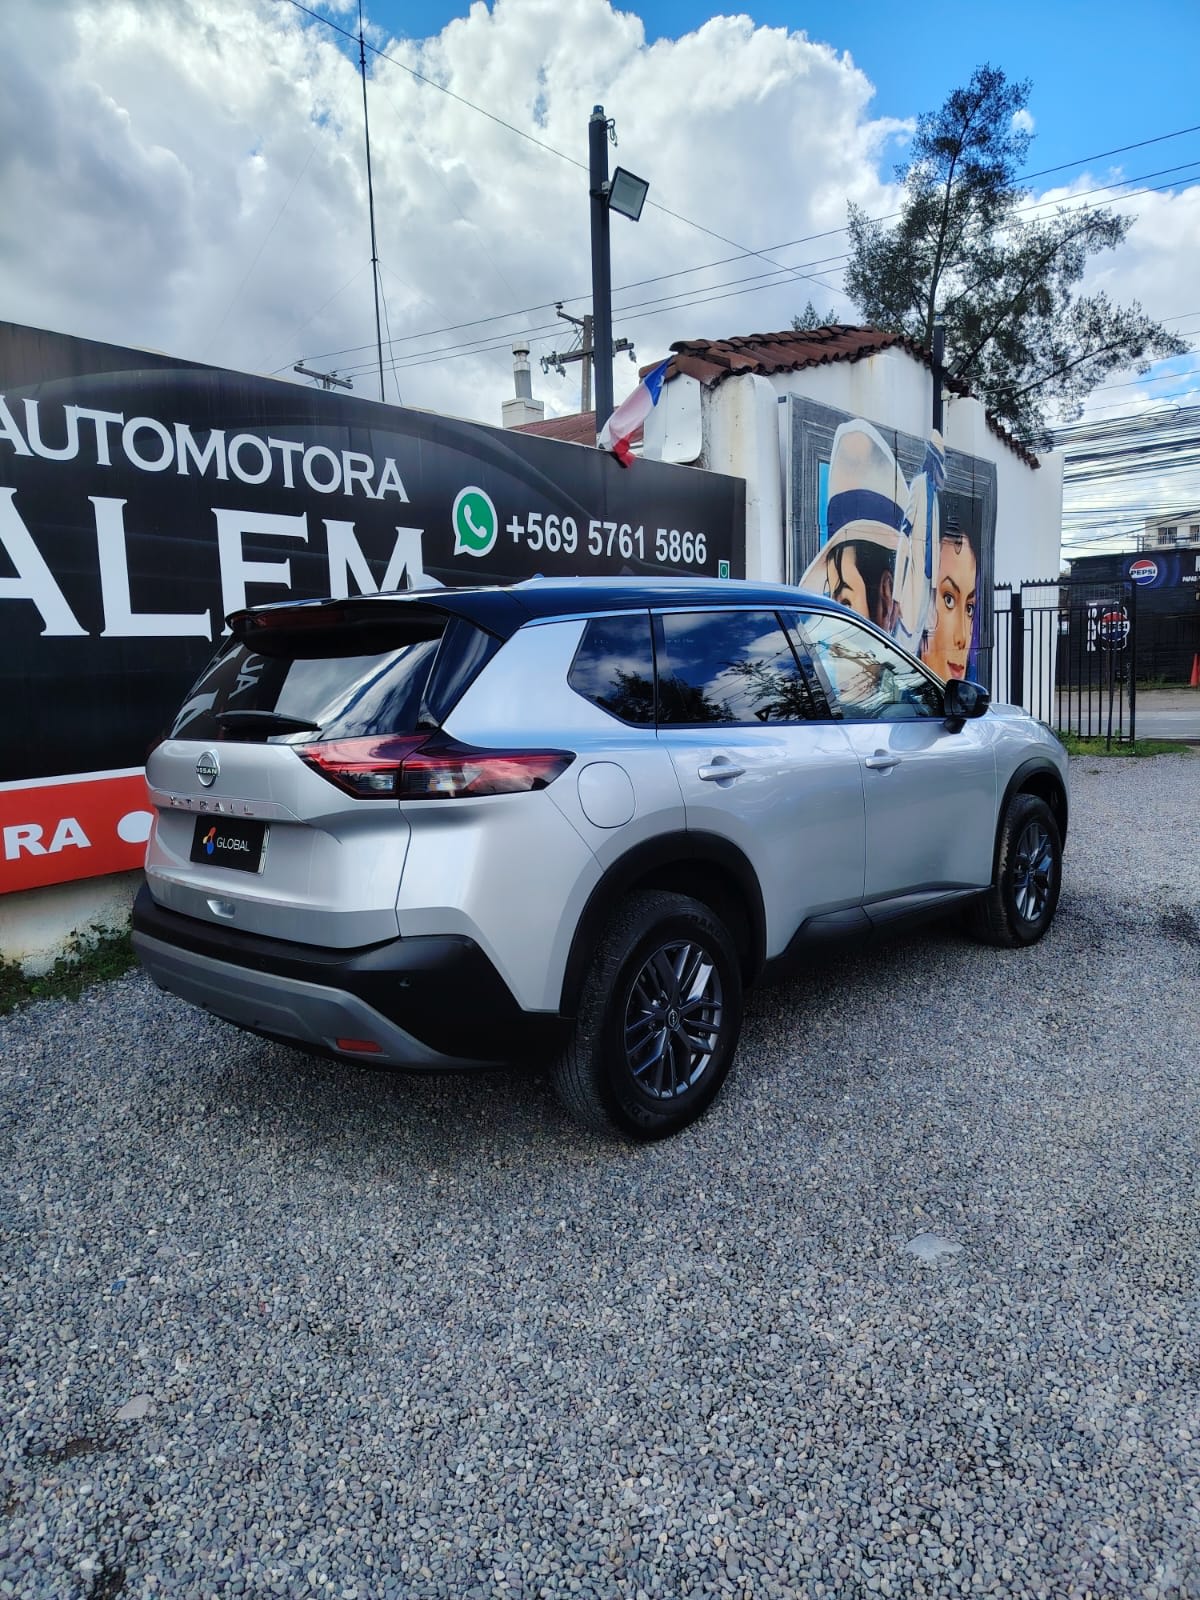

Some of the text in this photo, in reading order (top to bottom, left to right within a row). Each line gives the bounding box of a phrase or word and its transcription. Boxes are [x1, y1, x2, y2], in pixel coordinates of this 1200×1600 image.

[0, 394, 411, 503] AUTOMOTORA
[506, 511, 707, 565] +569 5761 5866
[216, 837, 250, 851] GLOBAL
